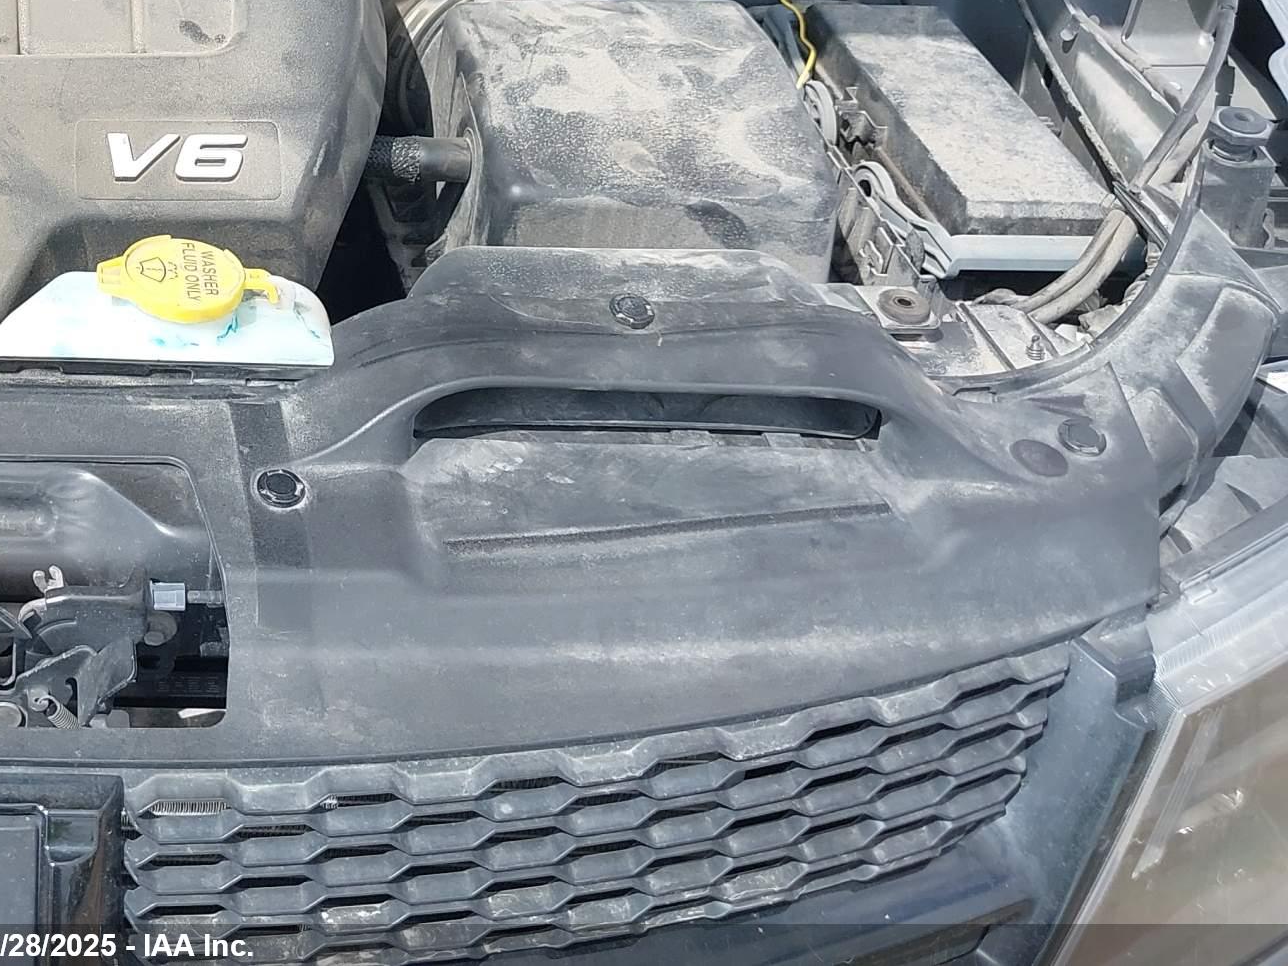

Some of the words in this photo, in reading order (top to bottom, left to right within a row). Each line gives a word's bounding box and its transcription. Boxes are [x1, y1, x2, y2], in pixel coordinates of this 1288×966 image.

[106, 133, 248, 183] V6
[180, 242, 199, 276] FLUID
[201, 250, 220, 296] WASHER
[184, 275, 201, 301] ONLY
